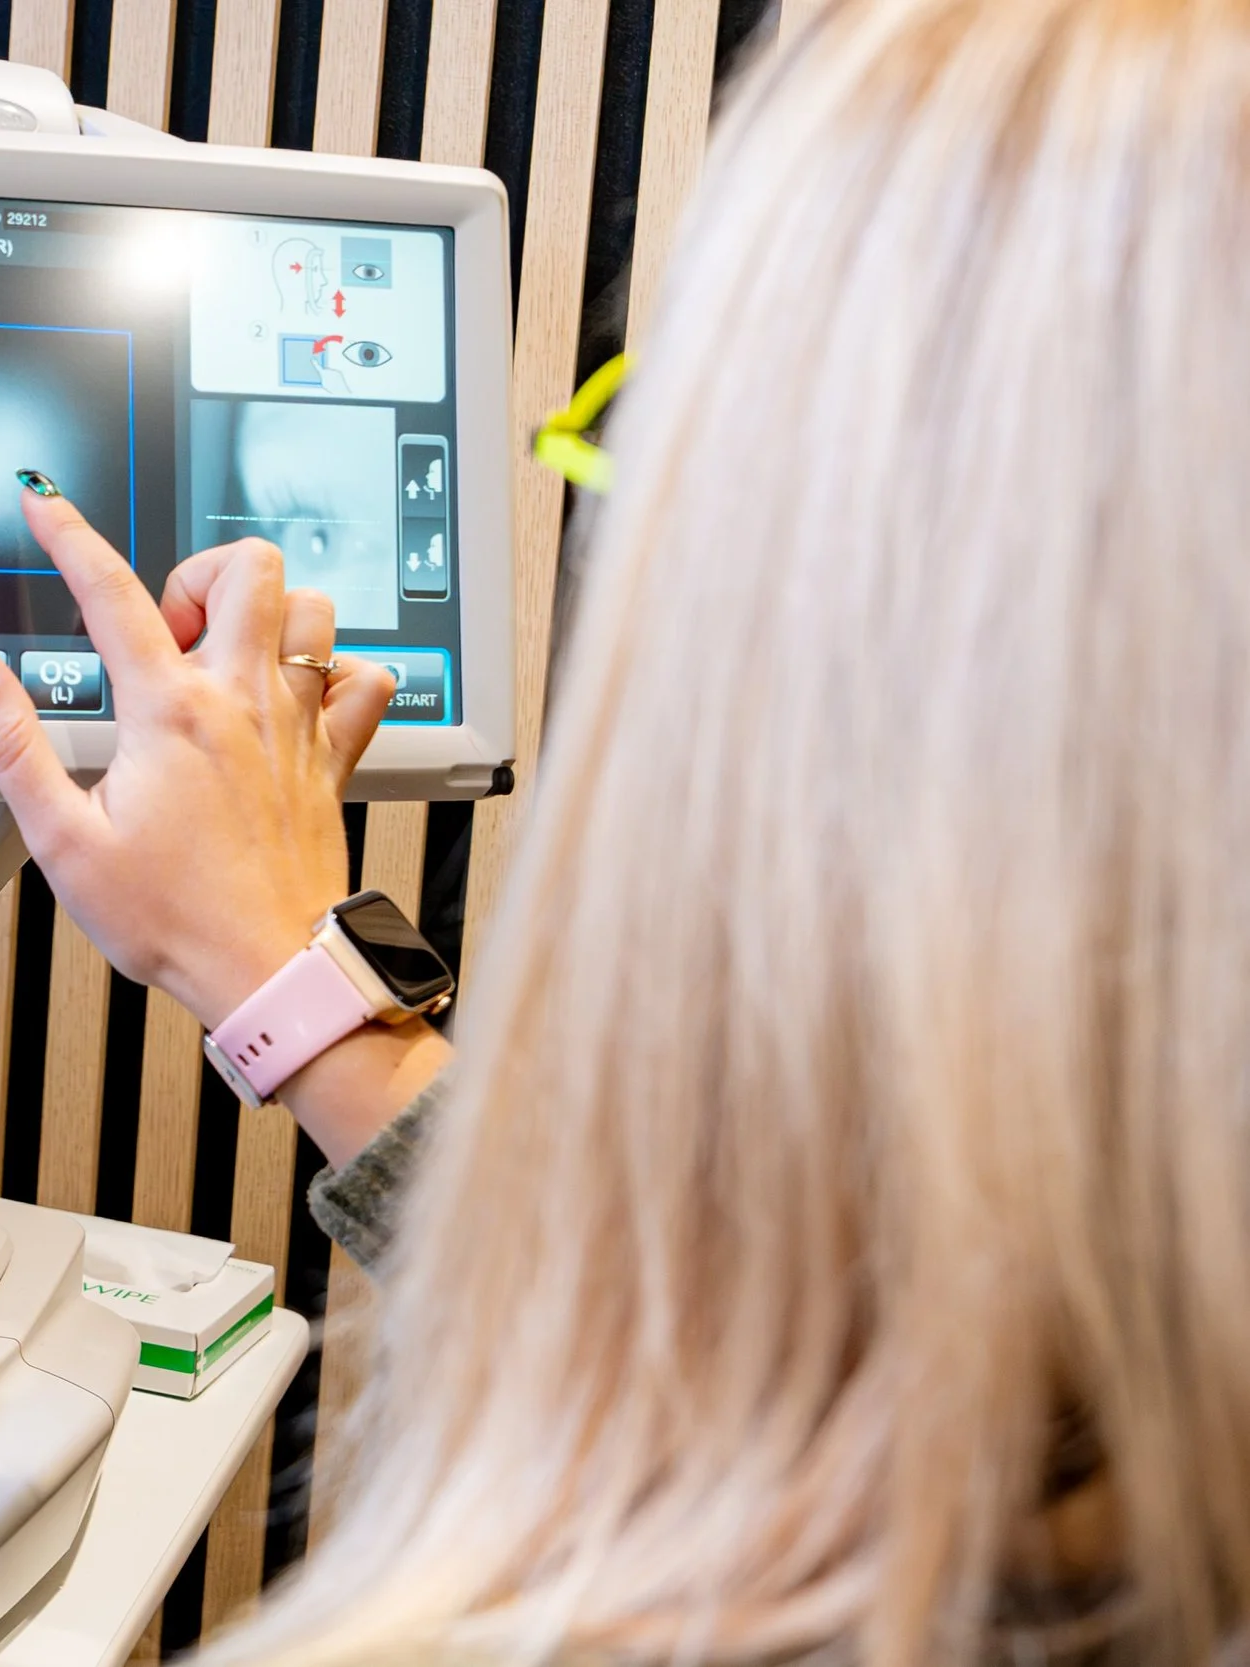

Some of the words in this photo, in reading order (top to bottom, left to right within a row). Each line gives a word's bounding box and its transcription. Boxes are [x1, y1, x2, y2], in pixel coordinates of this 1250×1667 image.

[6, 212, 48, 228] 29212
[39, 660, 83, 686] OS
[51, 686, 74, 704] (L)
[395, 693, 438, 707] START
[83, 1281, 161, 1305] WIPE
